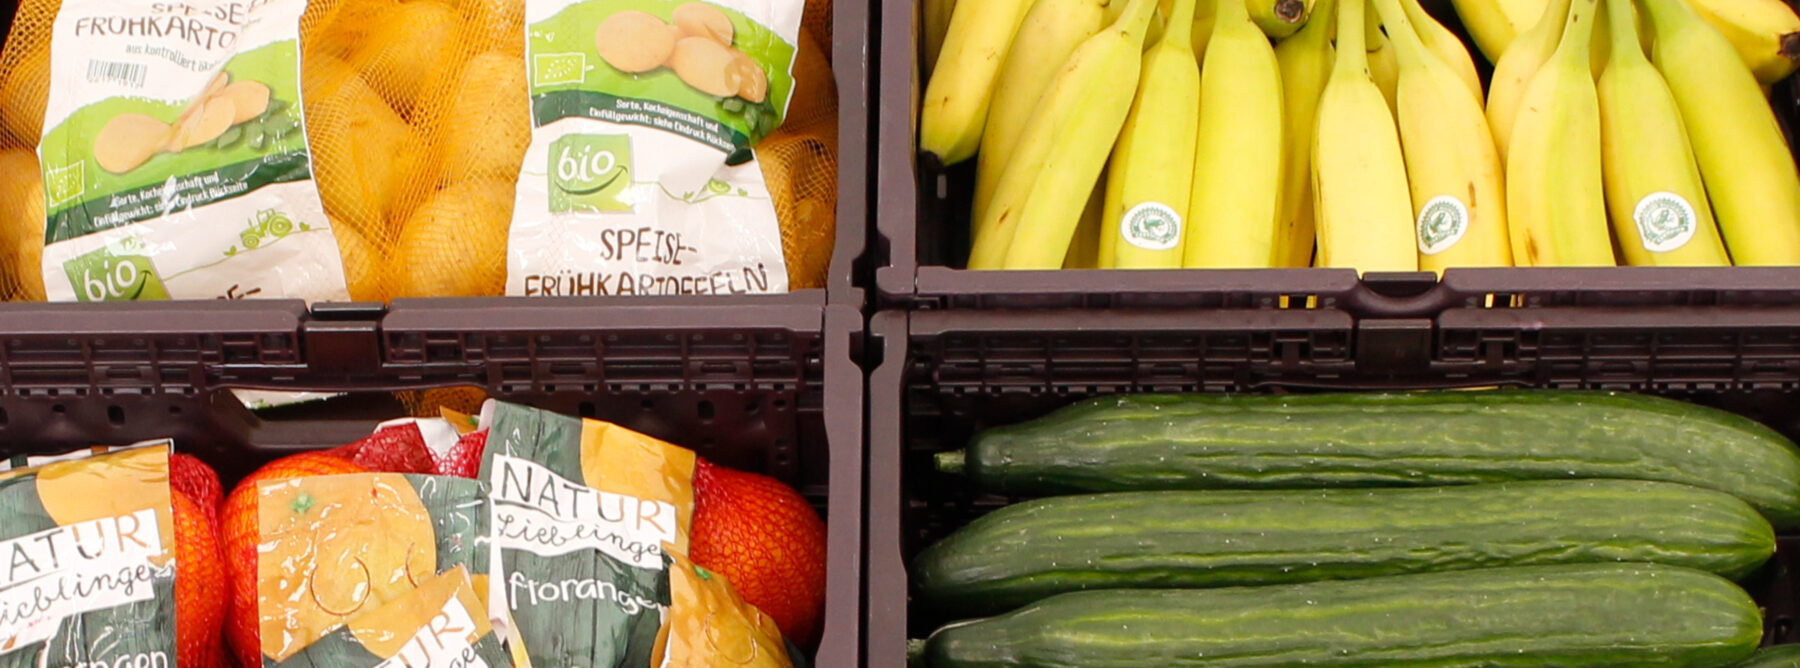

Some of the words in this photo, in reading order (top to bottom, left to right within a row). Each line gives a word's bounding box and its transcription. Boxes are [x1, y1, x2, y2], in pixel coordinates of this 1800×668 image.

[616, 99, 642, 111] Sorte,
[674, 122, 705, 139] Eindruck
[558, 144, 617, 182] bio
[601, 227, 698, 265] SPEISE-
[84, 260, 137, 301] bio
[502, 461, 667, 534] NATUR
